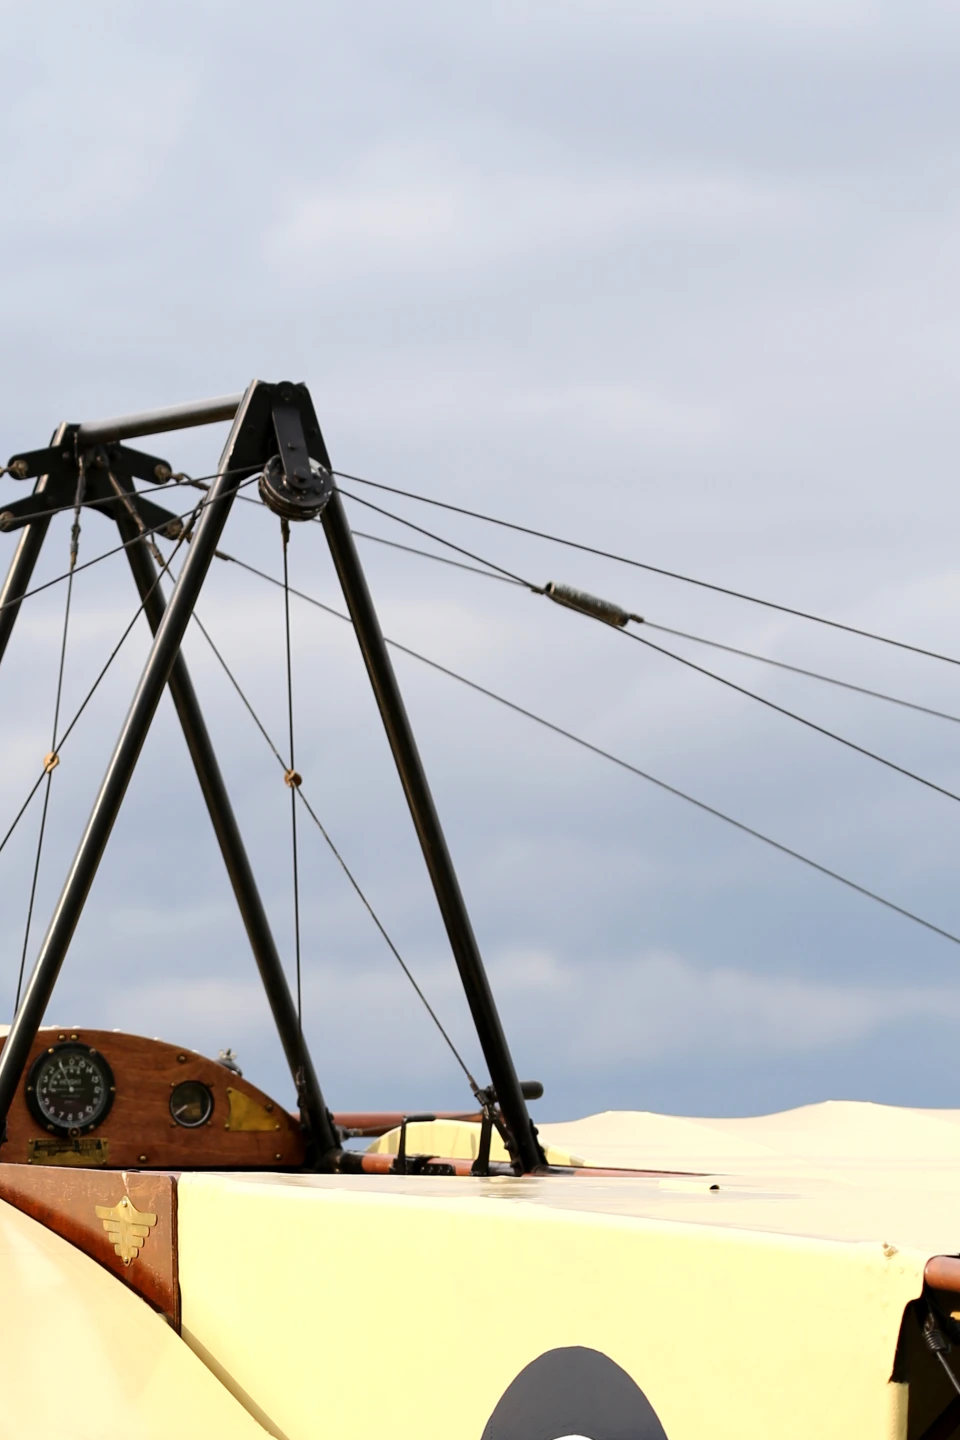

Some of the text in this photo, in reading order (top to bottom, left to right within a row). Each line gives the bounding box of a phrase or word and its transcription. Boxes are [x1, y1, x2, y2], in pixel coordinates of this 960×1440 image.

[49, 1066, 55, 1074] 2
[85, 1066, 93, 1074] 14
[43, 1075, 48, 1083] 3
[41, 1086, 47, 1094] 4
[44, 1097, 50, 1105] 5
[49, 1106, 55, 1114] 6
[85, 1105, 93, 1113] 10
[58, 1111, 65, 1119] 7
[67, 1113, 73, 1121] 8
